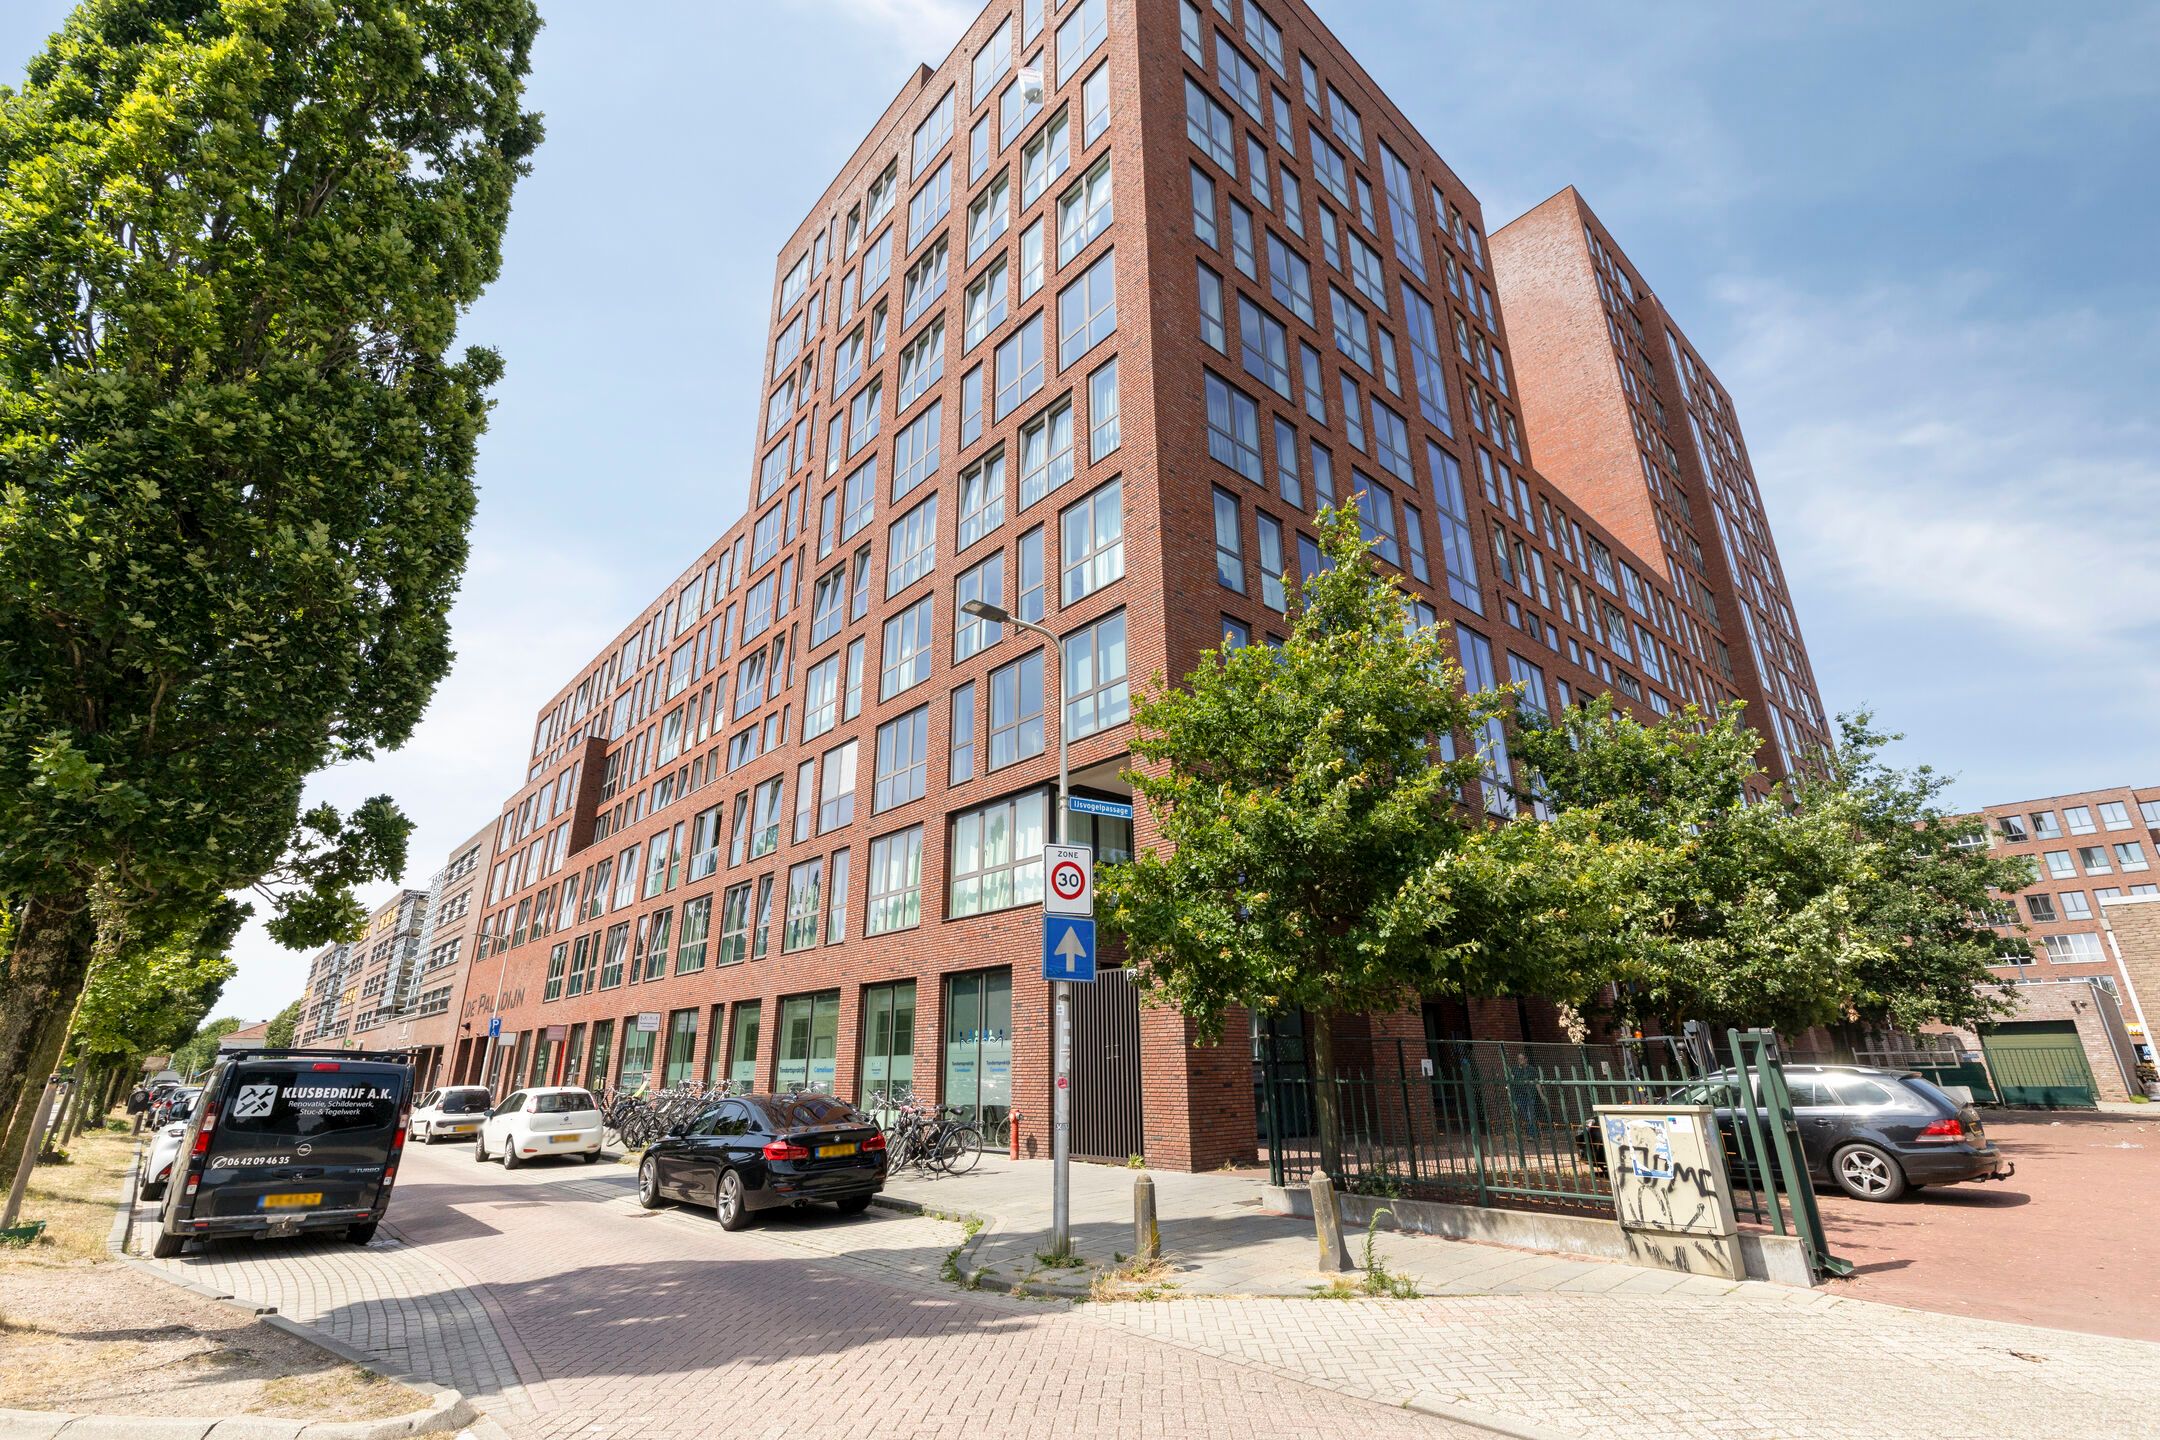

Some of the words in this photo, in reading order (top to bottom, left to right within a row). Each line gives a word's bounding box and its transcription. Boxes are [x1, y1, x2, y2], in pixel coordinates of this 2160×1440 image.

[1073, 800, 1128, 815] IJsvogelpassage
[1057, 873, 1079, 887] 30
[465, 1000, 477, 1018] DE
[478, 988, 525, 1014] PALDIJN
[281, 1087, 365, 1099] KLUSBEDRIJF
[367, 1088, 392, 1099] A.K.
[288, 1100, 326, 1108] Renovatie,
[325, 1108, 360, 1116] Tegelwerk
